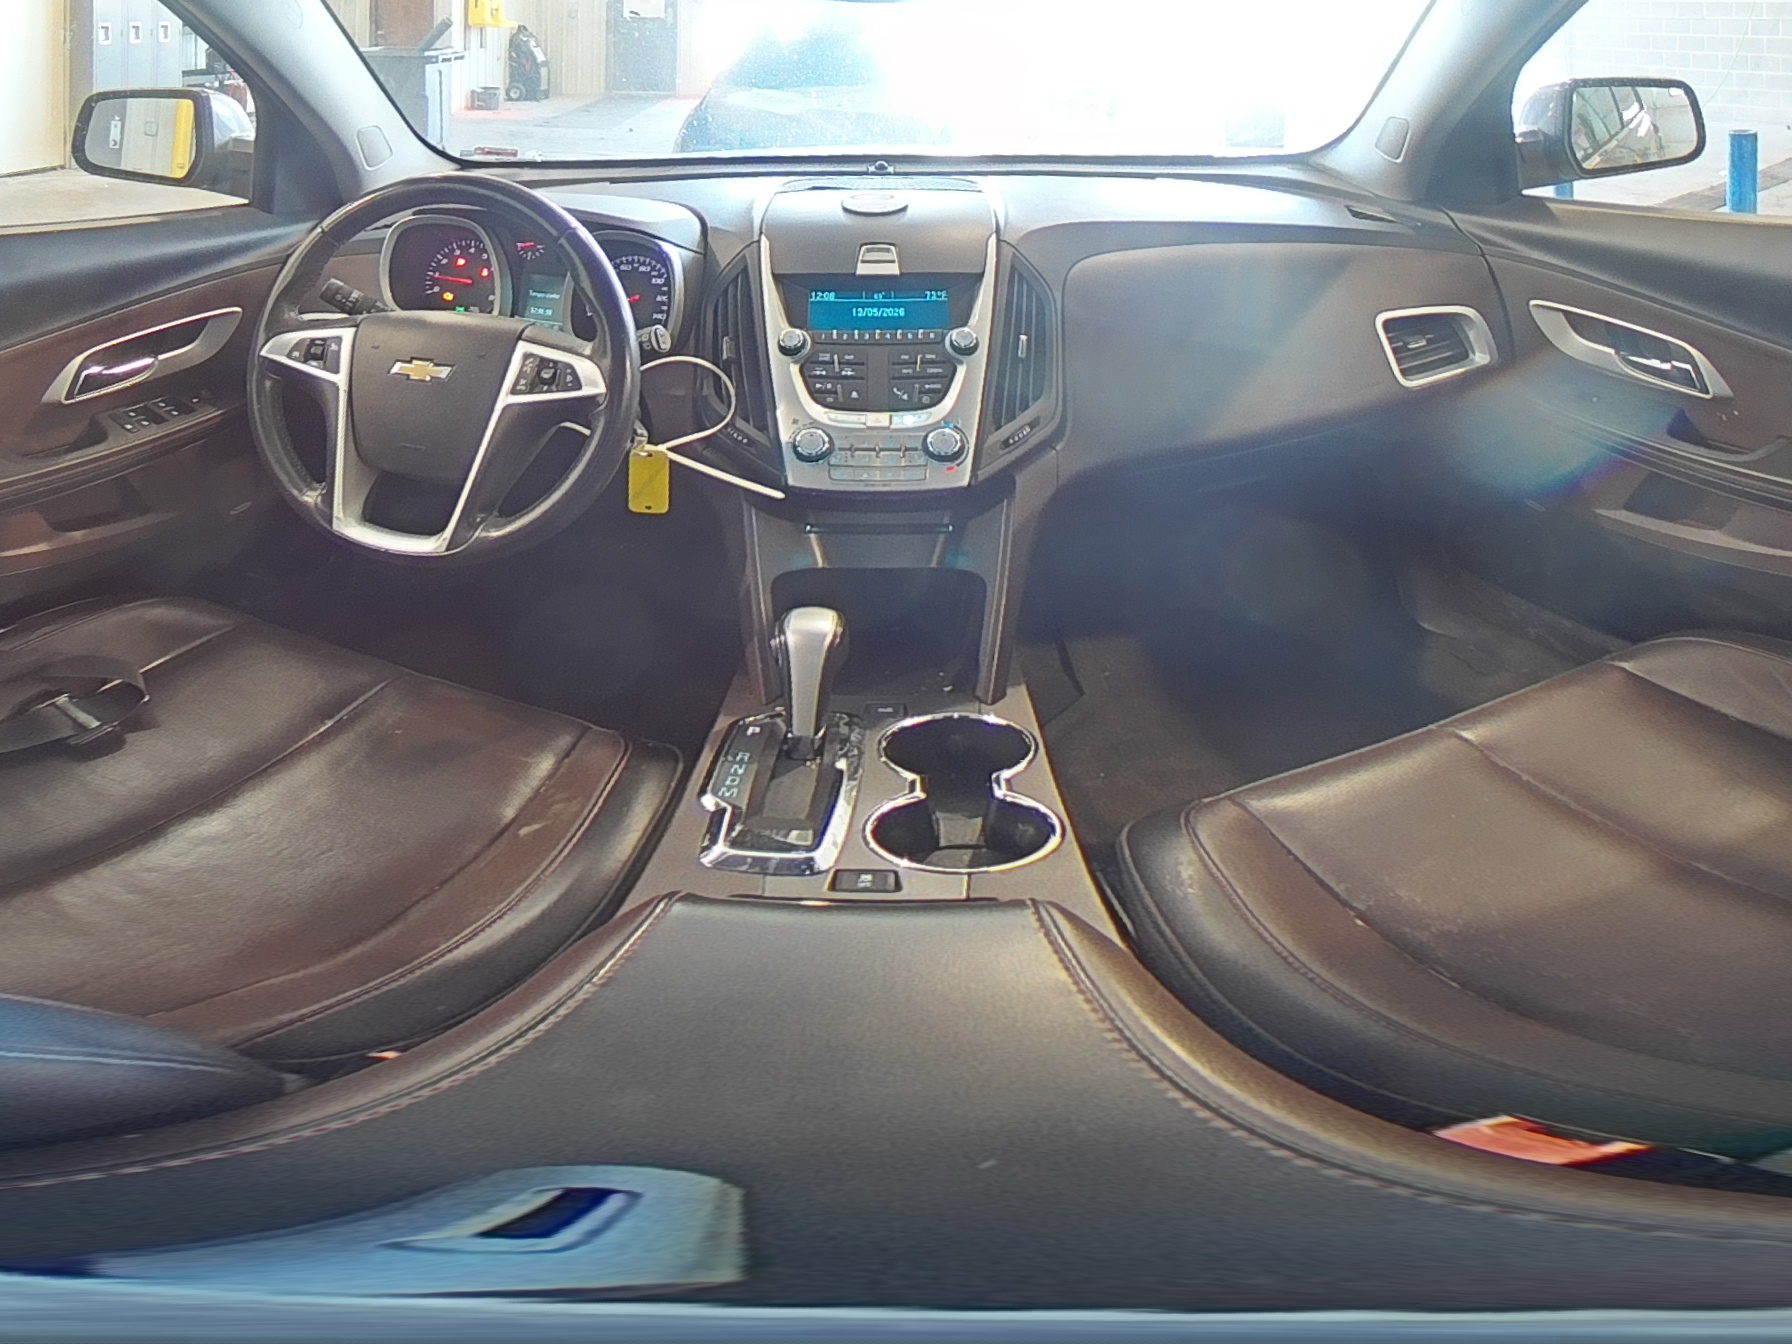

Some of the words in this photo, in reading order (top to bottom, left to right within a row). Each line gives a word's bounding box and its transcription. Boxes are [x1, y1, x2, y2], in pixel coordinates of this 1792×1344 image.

[746, 726, 761, 736] P
[730, 764, 746, 775] N
[725, 776, 740, 786] D
[718, 787, 738, 798] M
